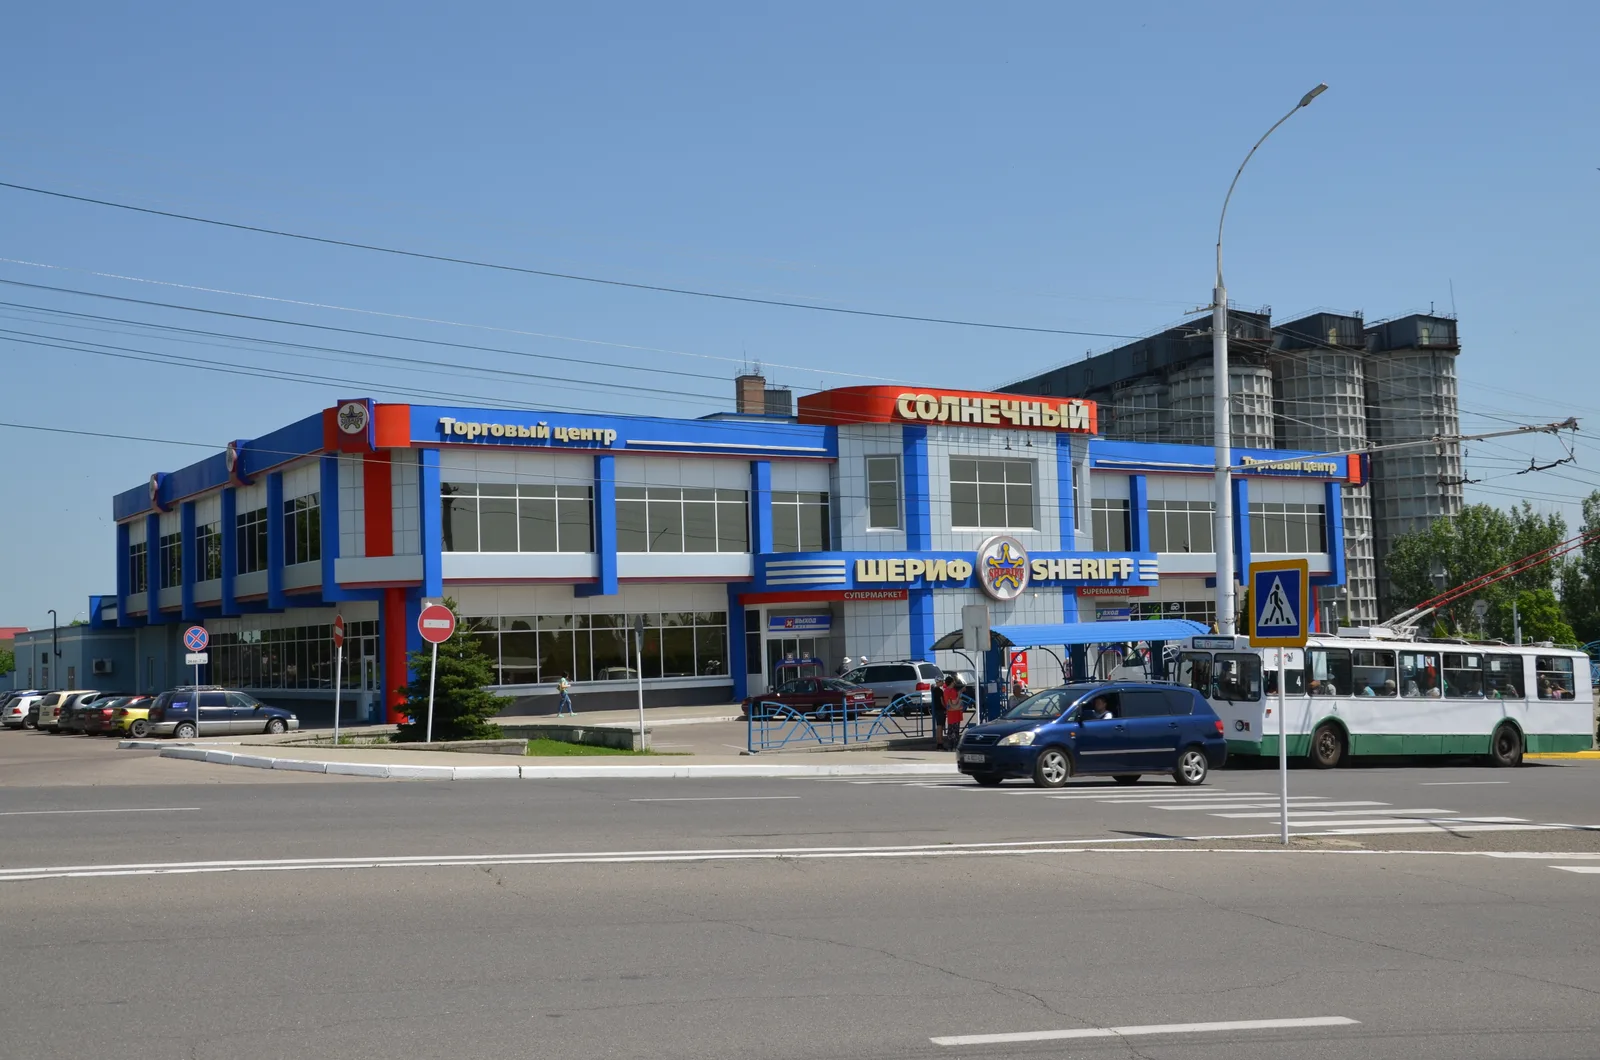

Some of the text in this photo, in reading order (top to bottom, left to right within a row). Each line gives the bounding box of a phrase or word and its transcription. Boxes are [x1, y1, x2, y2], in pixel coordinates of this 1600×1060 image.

[897, 393, 1090, 429] СОЛНЕЧНЫЙ
[439, 417, 617, 445] Торговый центр
[1303, 461, 1337, 474] центр
[855, 558, 973, 582] ШЕРИФ
[988, 567, 1025, 582] SHERIFF
[1031, 558, 1134, 580] SHERIFF
[844, 591, 902, 599] СУПЕРМАРКЕТ
[1296, 676, 1301, 687] 4
[1332, 701, 1337, 711] 4
